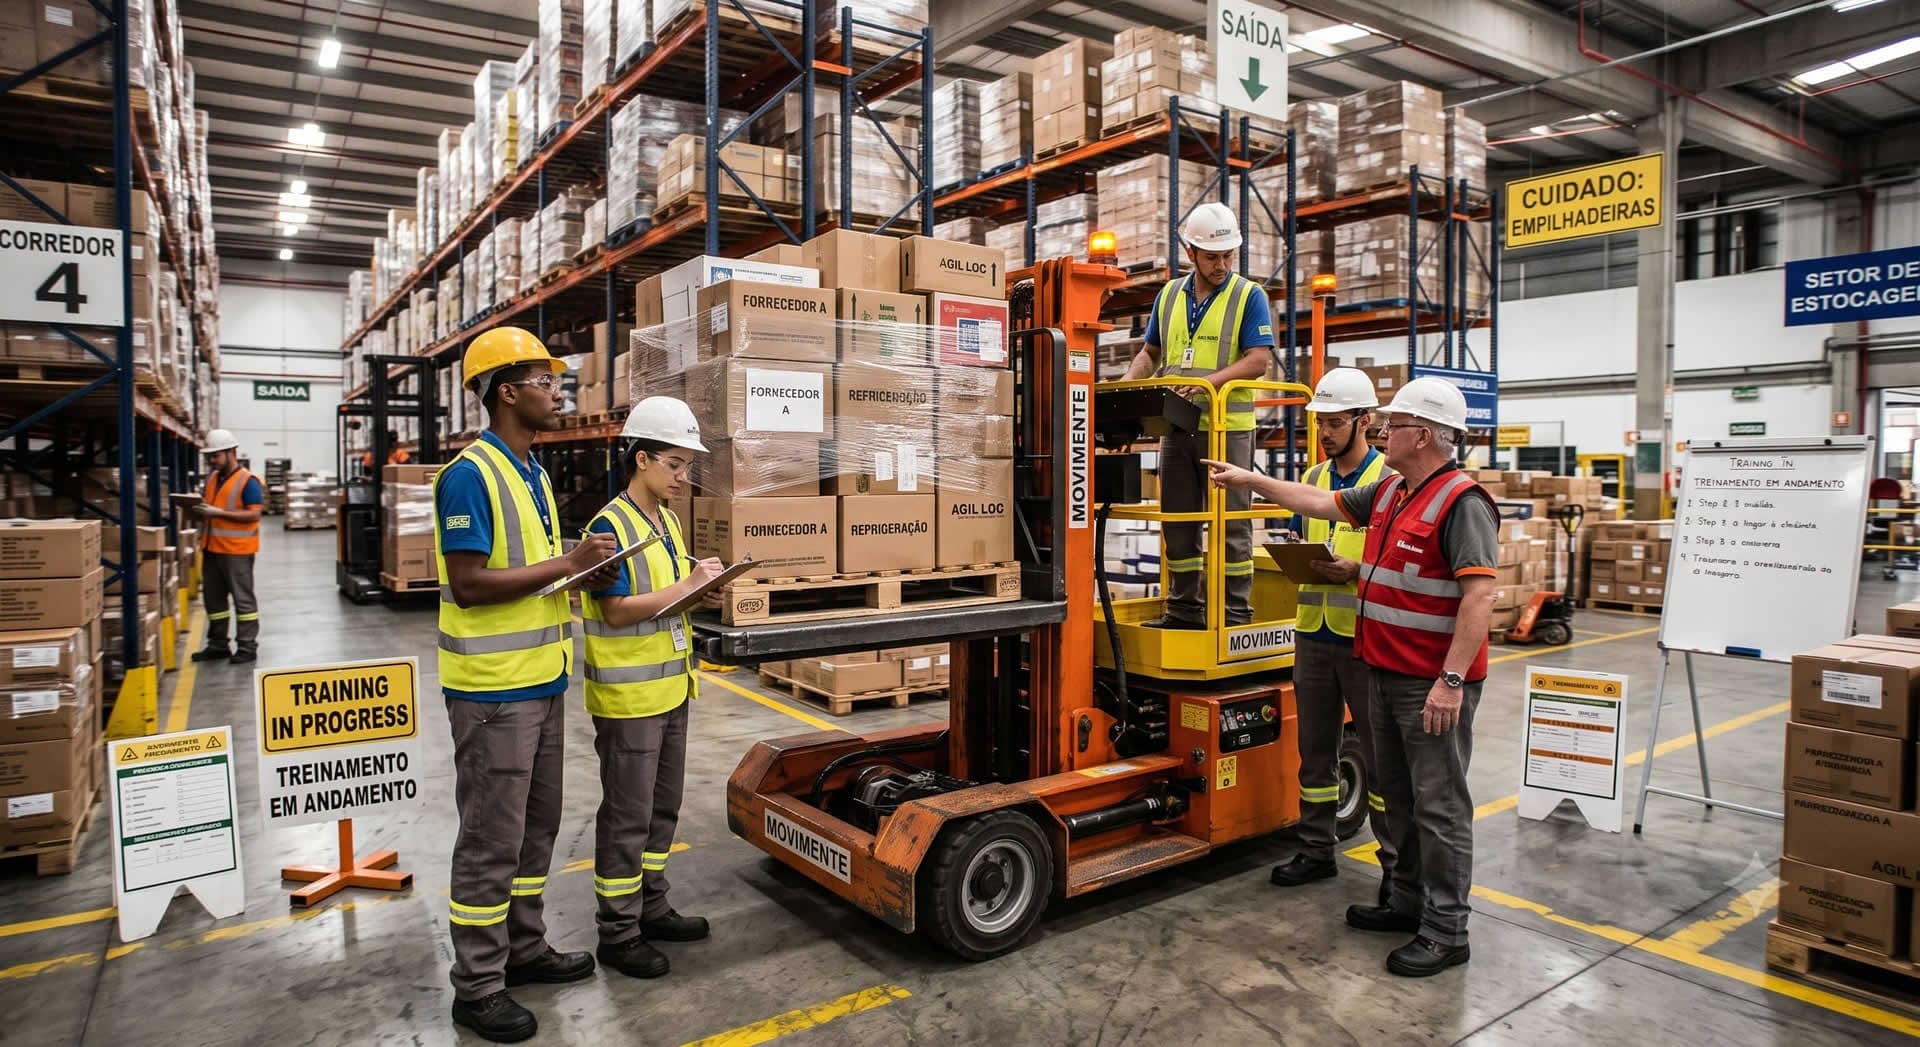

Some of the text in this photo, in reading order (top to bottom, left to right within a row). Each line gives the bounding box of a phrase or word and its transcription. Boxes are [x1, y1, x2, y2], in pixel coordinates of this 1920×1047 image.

[1222, 9, 1284, 52] SAÍDA
[1522, 170, 1643, 209] CUIDADO:
[1512, 197, 1655, 237] EMPILHADEIRAS
[0, 229, 116, 257] CORREDOR
[939, 257, 987, 274] AGIL LOC
[1805, 261, 1920, 289] SETOR DE
[35, 262, 88, 314] 4
[1791, 285, 1920, 313] ESTOCAGE
[819, 302, 827, 314] A
[751, 386, 820, 400] FORNECEDOR
[782, 405, 790, 415] A
[1072, 390, 1086, 521] MOVIMENTE
[1694, 477, 1845, 488] TREINAMENTO EM ANDAMENTO
[951, 503, 1004, 516] AGIL LOC
[820, 523, 828, 534] A
[290, 675, 388, 706] TRAINING
[272, 704, 408, 740] IN PROGRESS
[276, 752, 408, 787] TREINAMENTO
[270, 779, 416, 818] EM ANDAMENTO
[767, 815, 848, 877] MOVIMENTE
